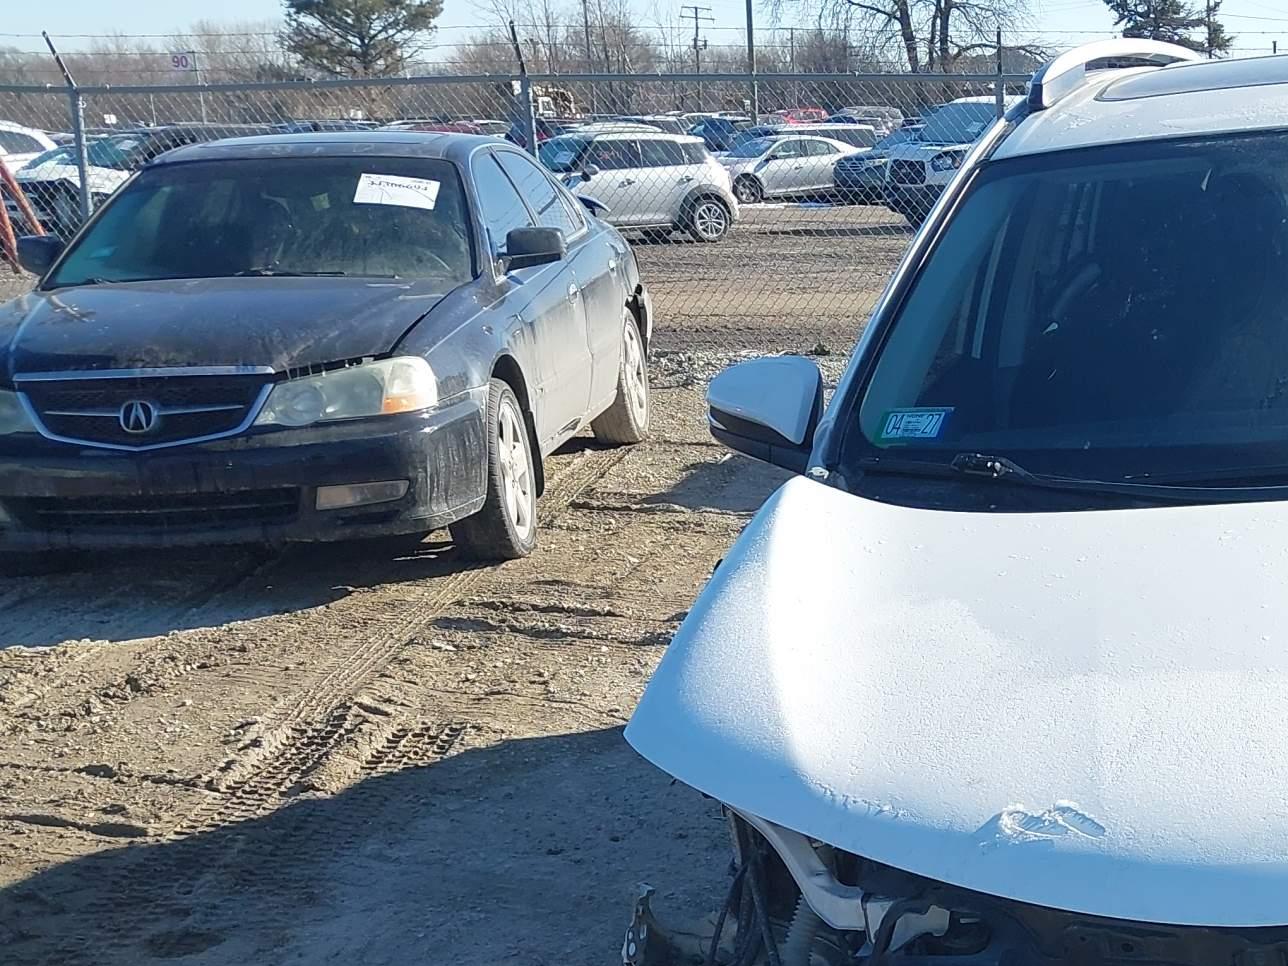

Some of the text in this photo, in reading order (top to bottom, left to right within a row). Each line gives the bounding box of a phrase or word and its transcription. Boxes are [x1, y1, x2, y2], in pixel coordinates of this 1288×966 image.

[172, 55, 188, 68] 90
[886, 414, 905, 434] 04
[920, 413, 942, 434] 27
